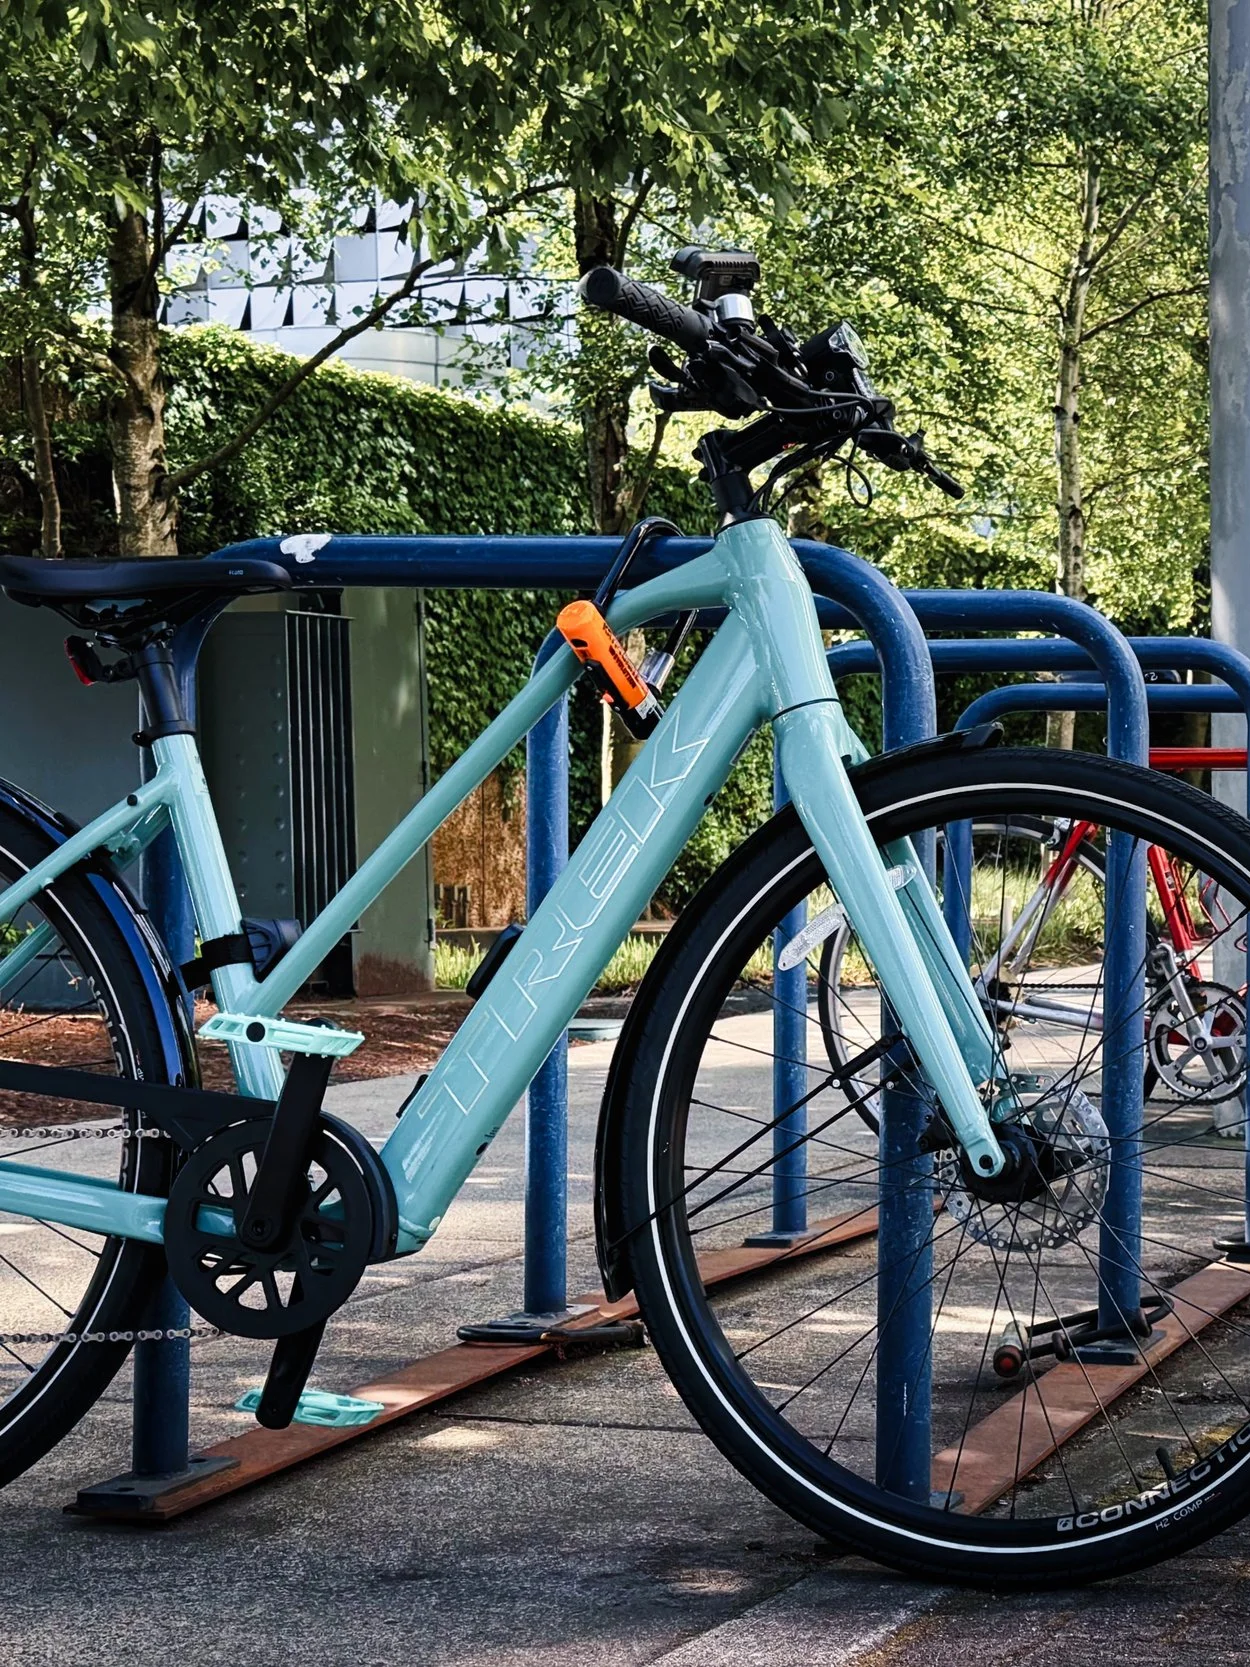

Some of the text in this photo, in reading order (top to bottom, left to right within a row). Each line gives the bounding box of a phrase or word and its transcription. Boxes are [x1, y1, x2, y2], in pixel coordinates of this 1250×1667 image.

[417, 705, 710, 1120] TREK
[1154, 1499, 1203, 1532] H2 COMP
